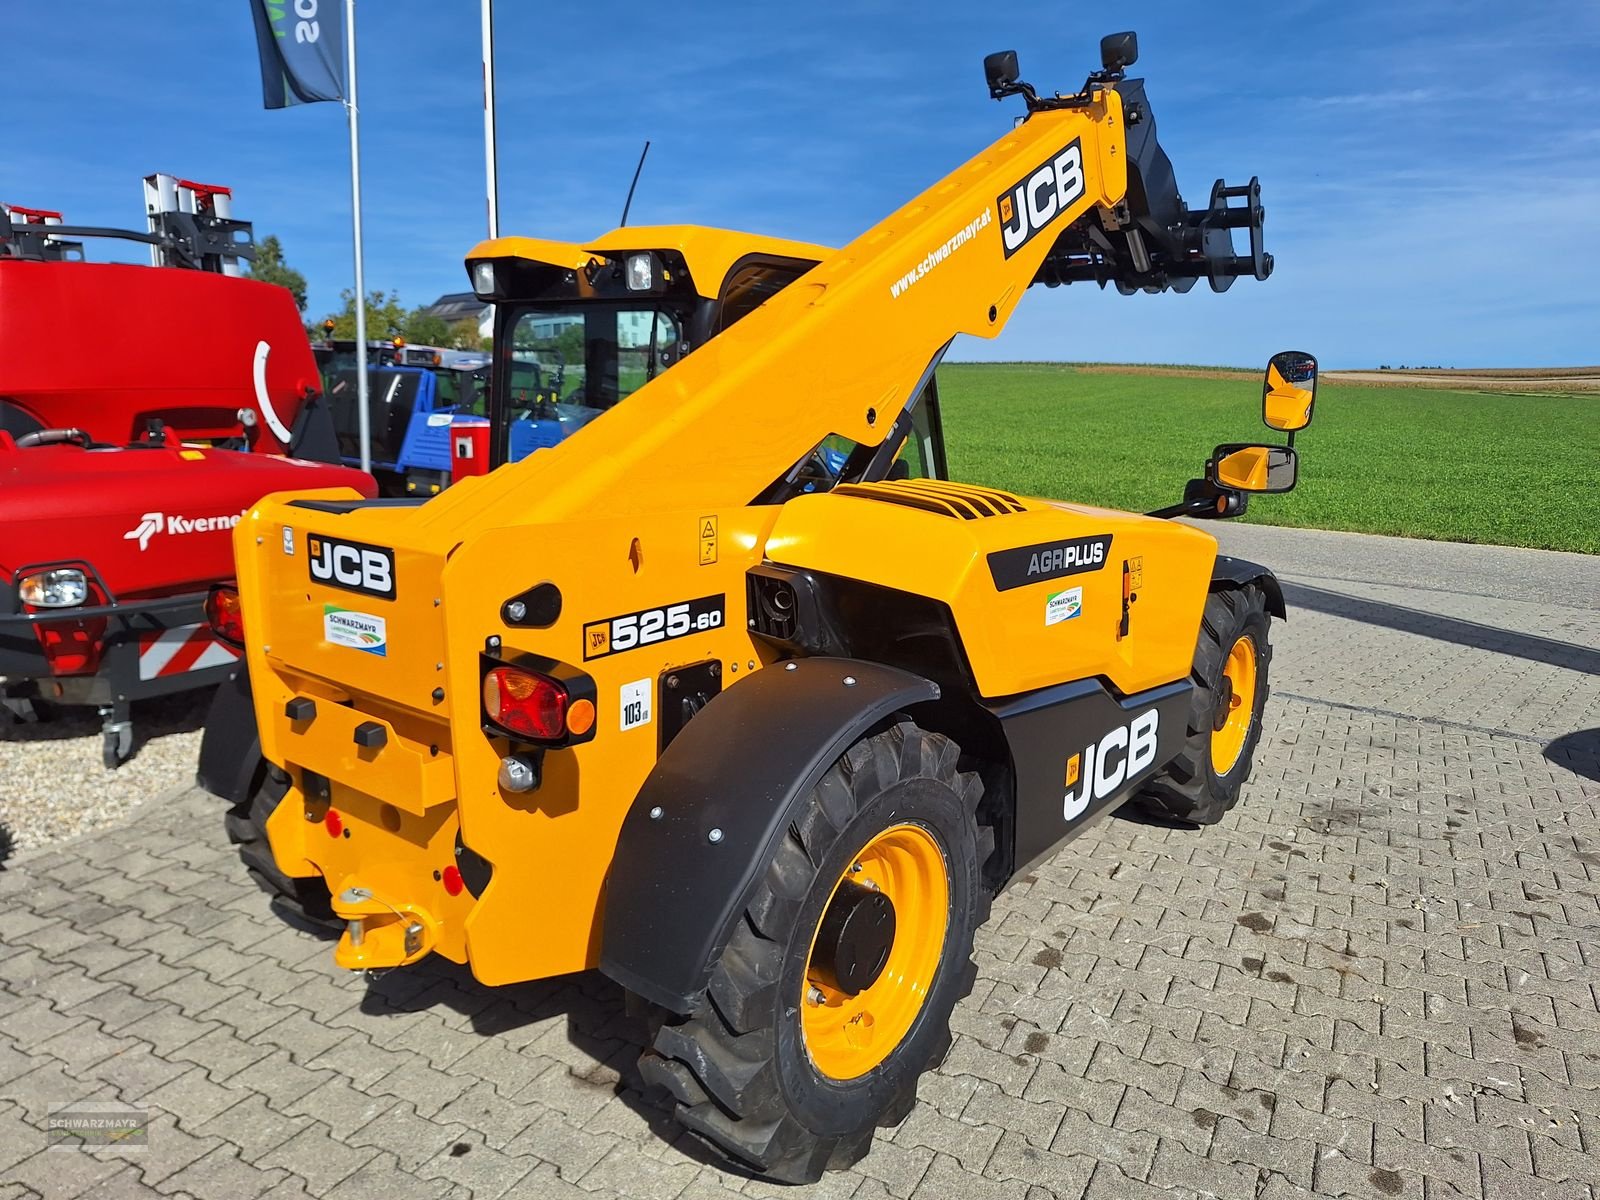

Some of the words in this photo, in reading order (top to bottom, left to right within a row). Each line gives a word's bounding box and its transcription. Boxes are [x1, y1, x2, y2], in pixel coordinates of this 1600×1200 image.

[1004, 146, 1083, 249] JCB
[890, 207, 992, 299] www.schwarzmayr.at
[167, 510, 247, 535] Kverne
[311, 541, 392, 592] JCB
[329, 614, 377, 633] SCHWARZMAYR
[592, 632, 606, 647] JCB
[624, 701, 642, 726] 103
[1064, 708, 1159, 821] JCB
